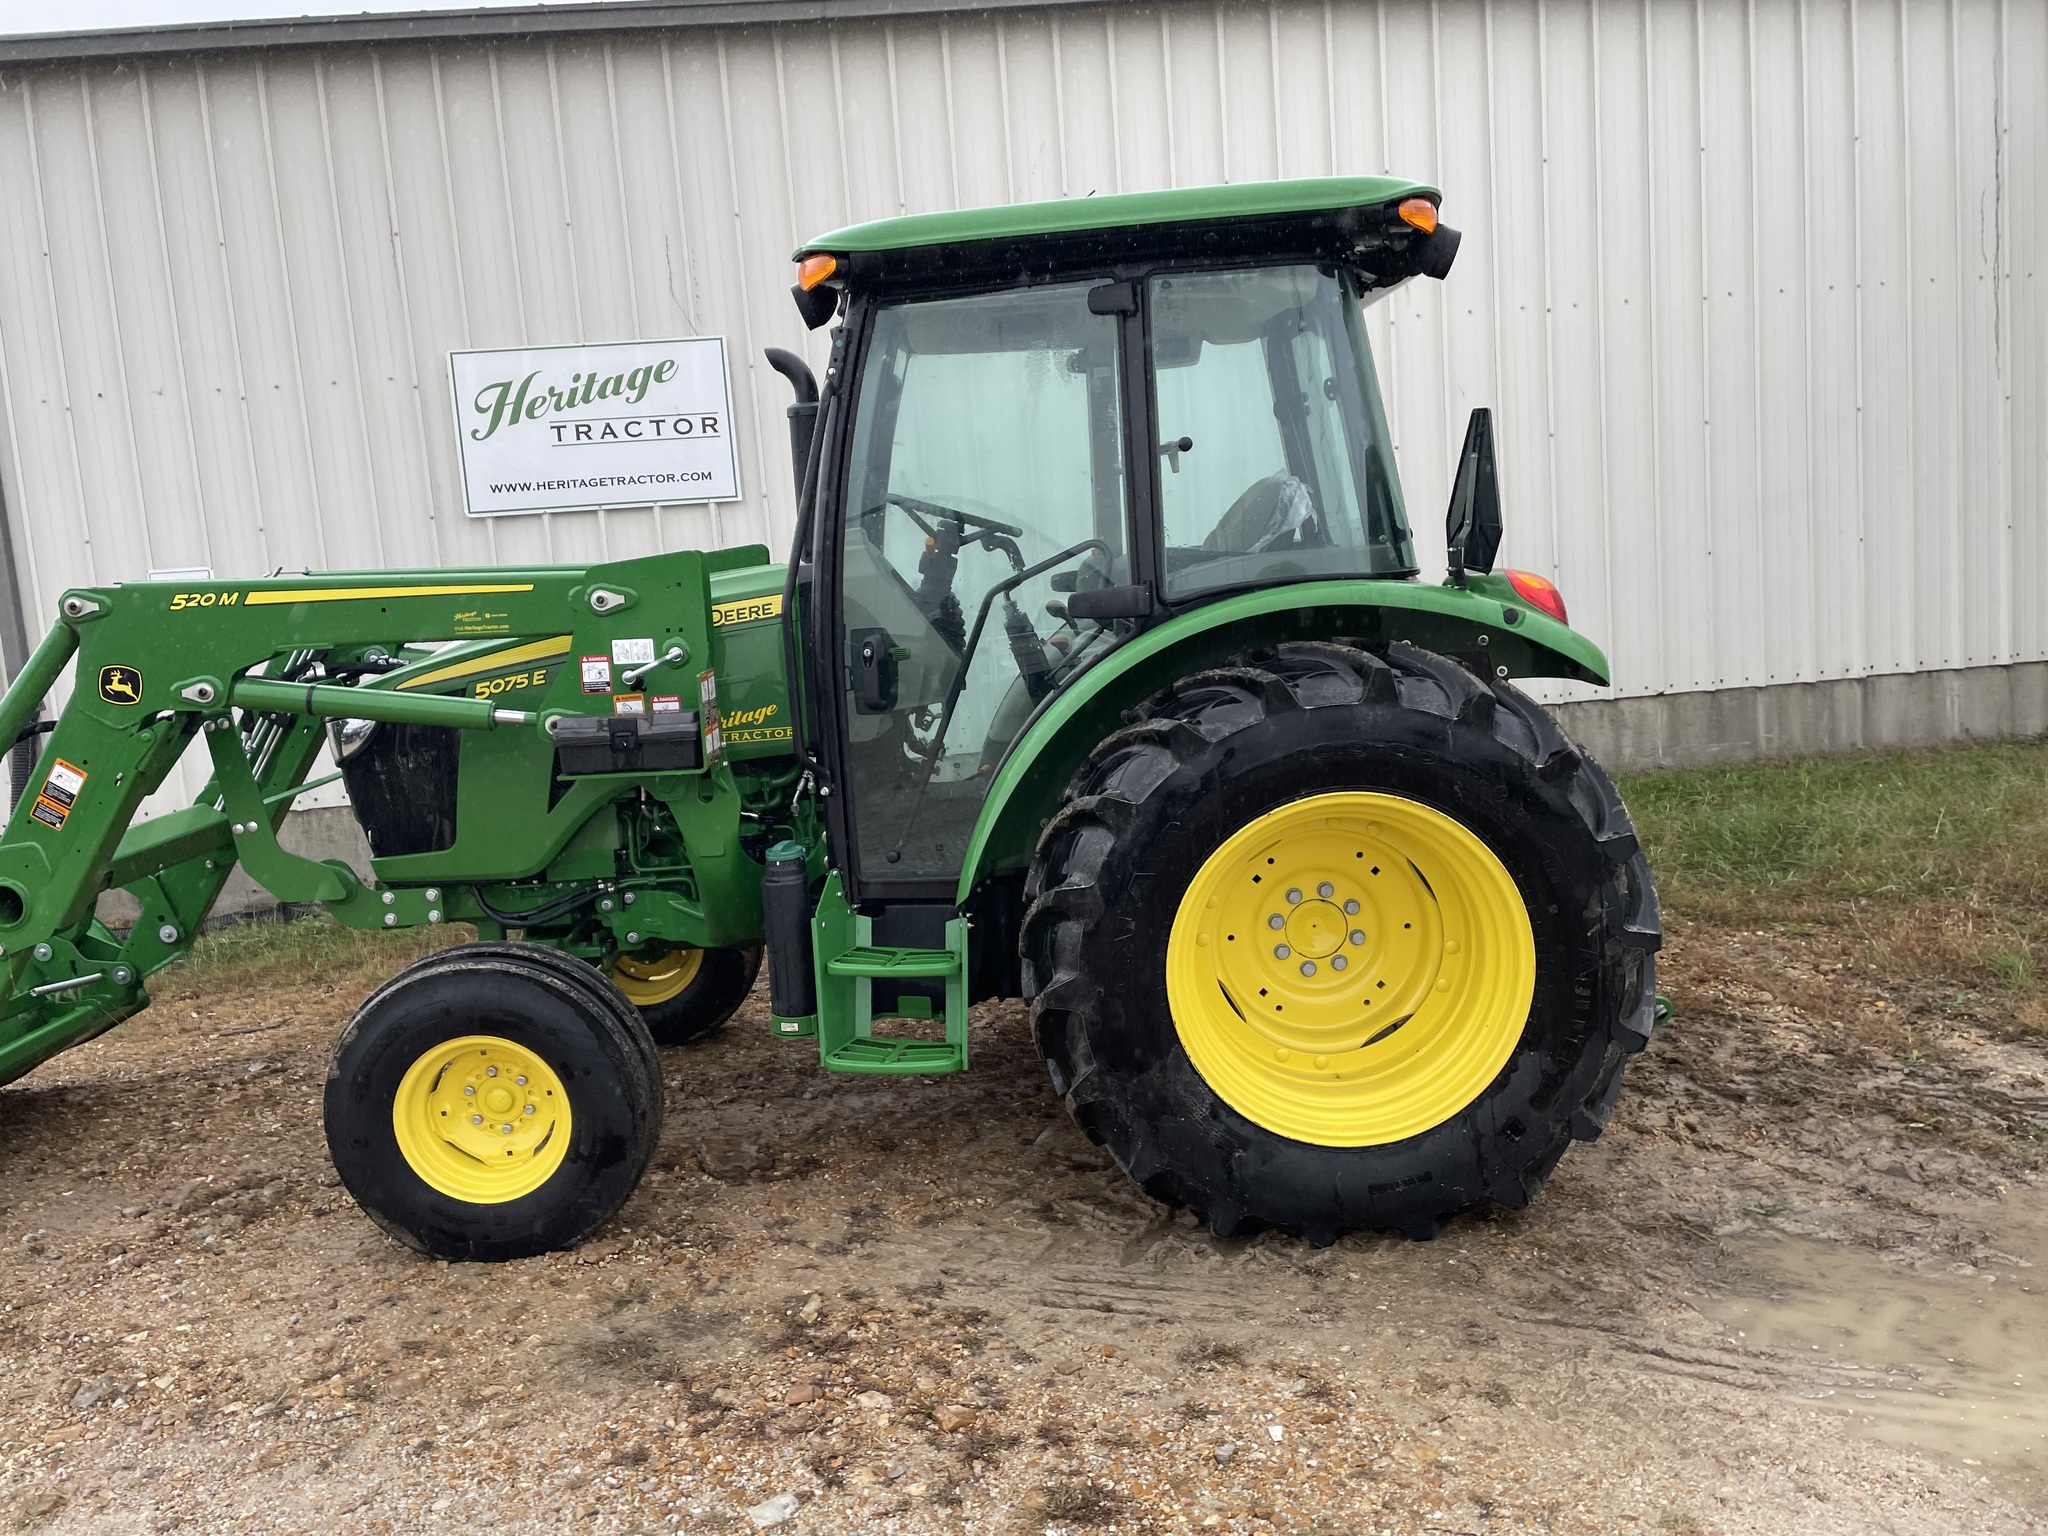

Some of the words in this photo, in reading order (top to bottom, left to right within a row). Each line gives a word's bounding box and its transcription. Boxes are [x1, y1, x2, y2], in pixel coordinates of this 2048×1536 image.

[470, 359, 680, 441] Heritage
[550, 416, 719, 442] TRACTOR
[489, 471, 713, 494] WWW.HERITAGETRACTOR.COM
[169, 592, 217, 611] 520
[218, 591, 240, 606] M
[712, 602, 774, 624] DEERE
[475, 672, 529, 700] 5075
[532, 669, 547, 686] E
[720, 703, 779, 729] ritage
